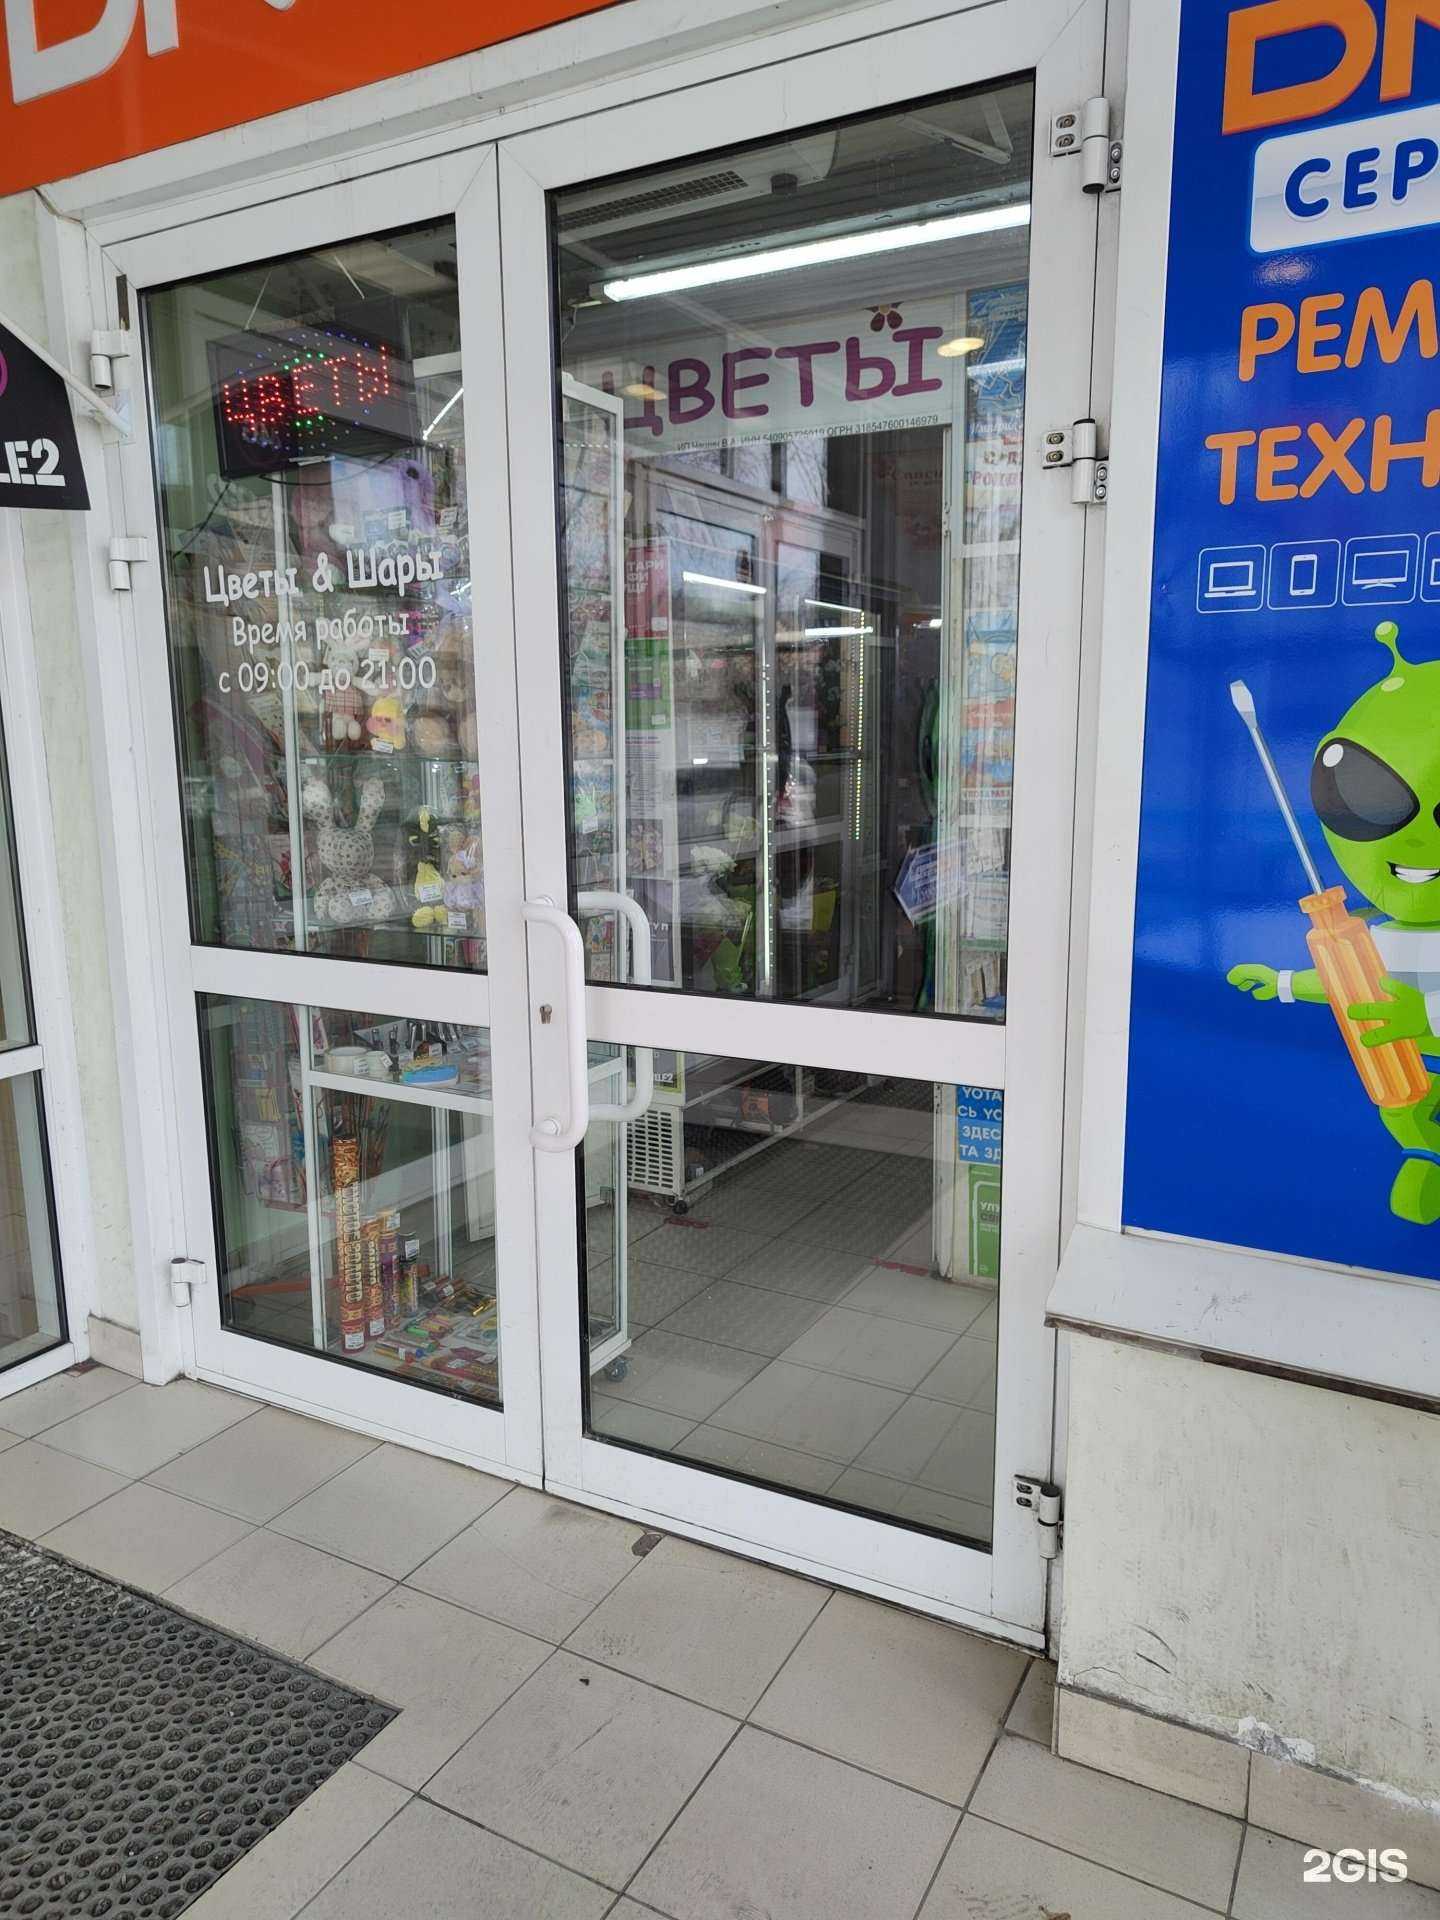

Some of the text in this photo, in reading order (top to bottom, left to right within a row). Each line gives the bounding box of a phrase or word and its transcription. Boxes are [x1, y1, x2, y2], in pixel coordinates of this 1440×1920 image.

[1285, 138, 1439, 218] СЕР
[1239, 279, 1439, 382] РЕМ
[827, 424, 853, 437] ОГРН
[1205, 408, 1440, 506] ТЕХН
[203, 549, 445, 607] Цветы & Шары
[232, 608, 410, 655] Время работы
[218, 655, 438, 695] с 09:00 до 21:00
